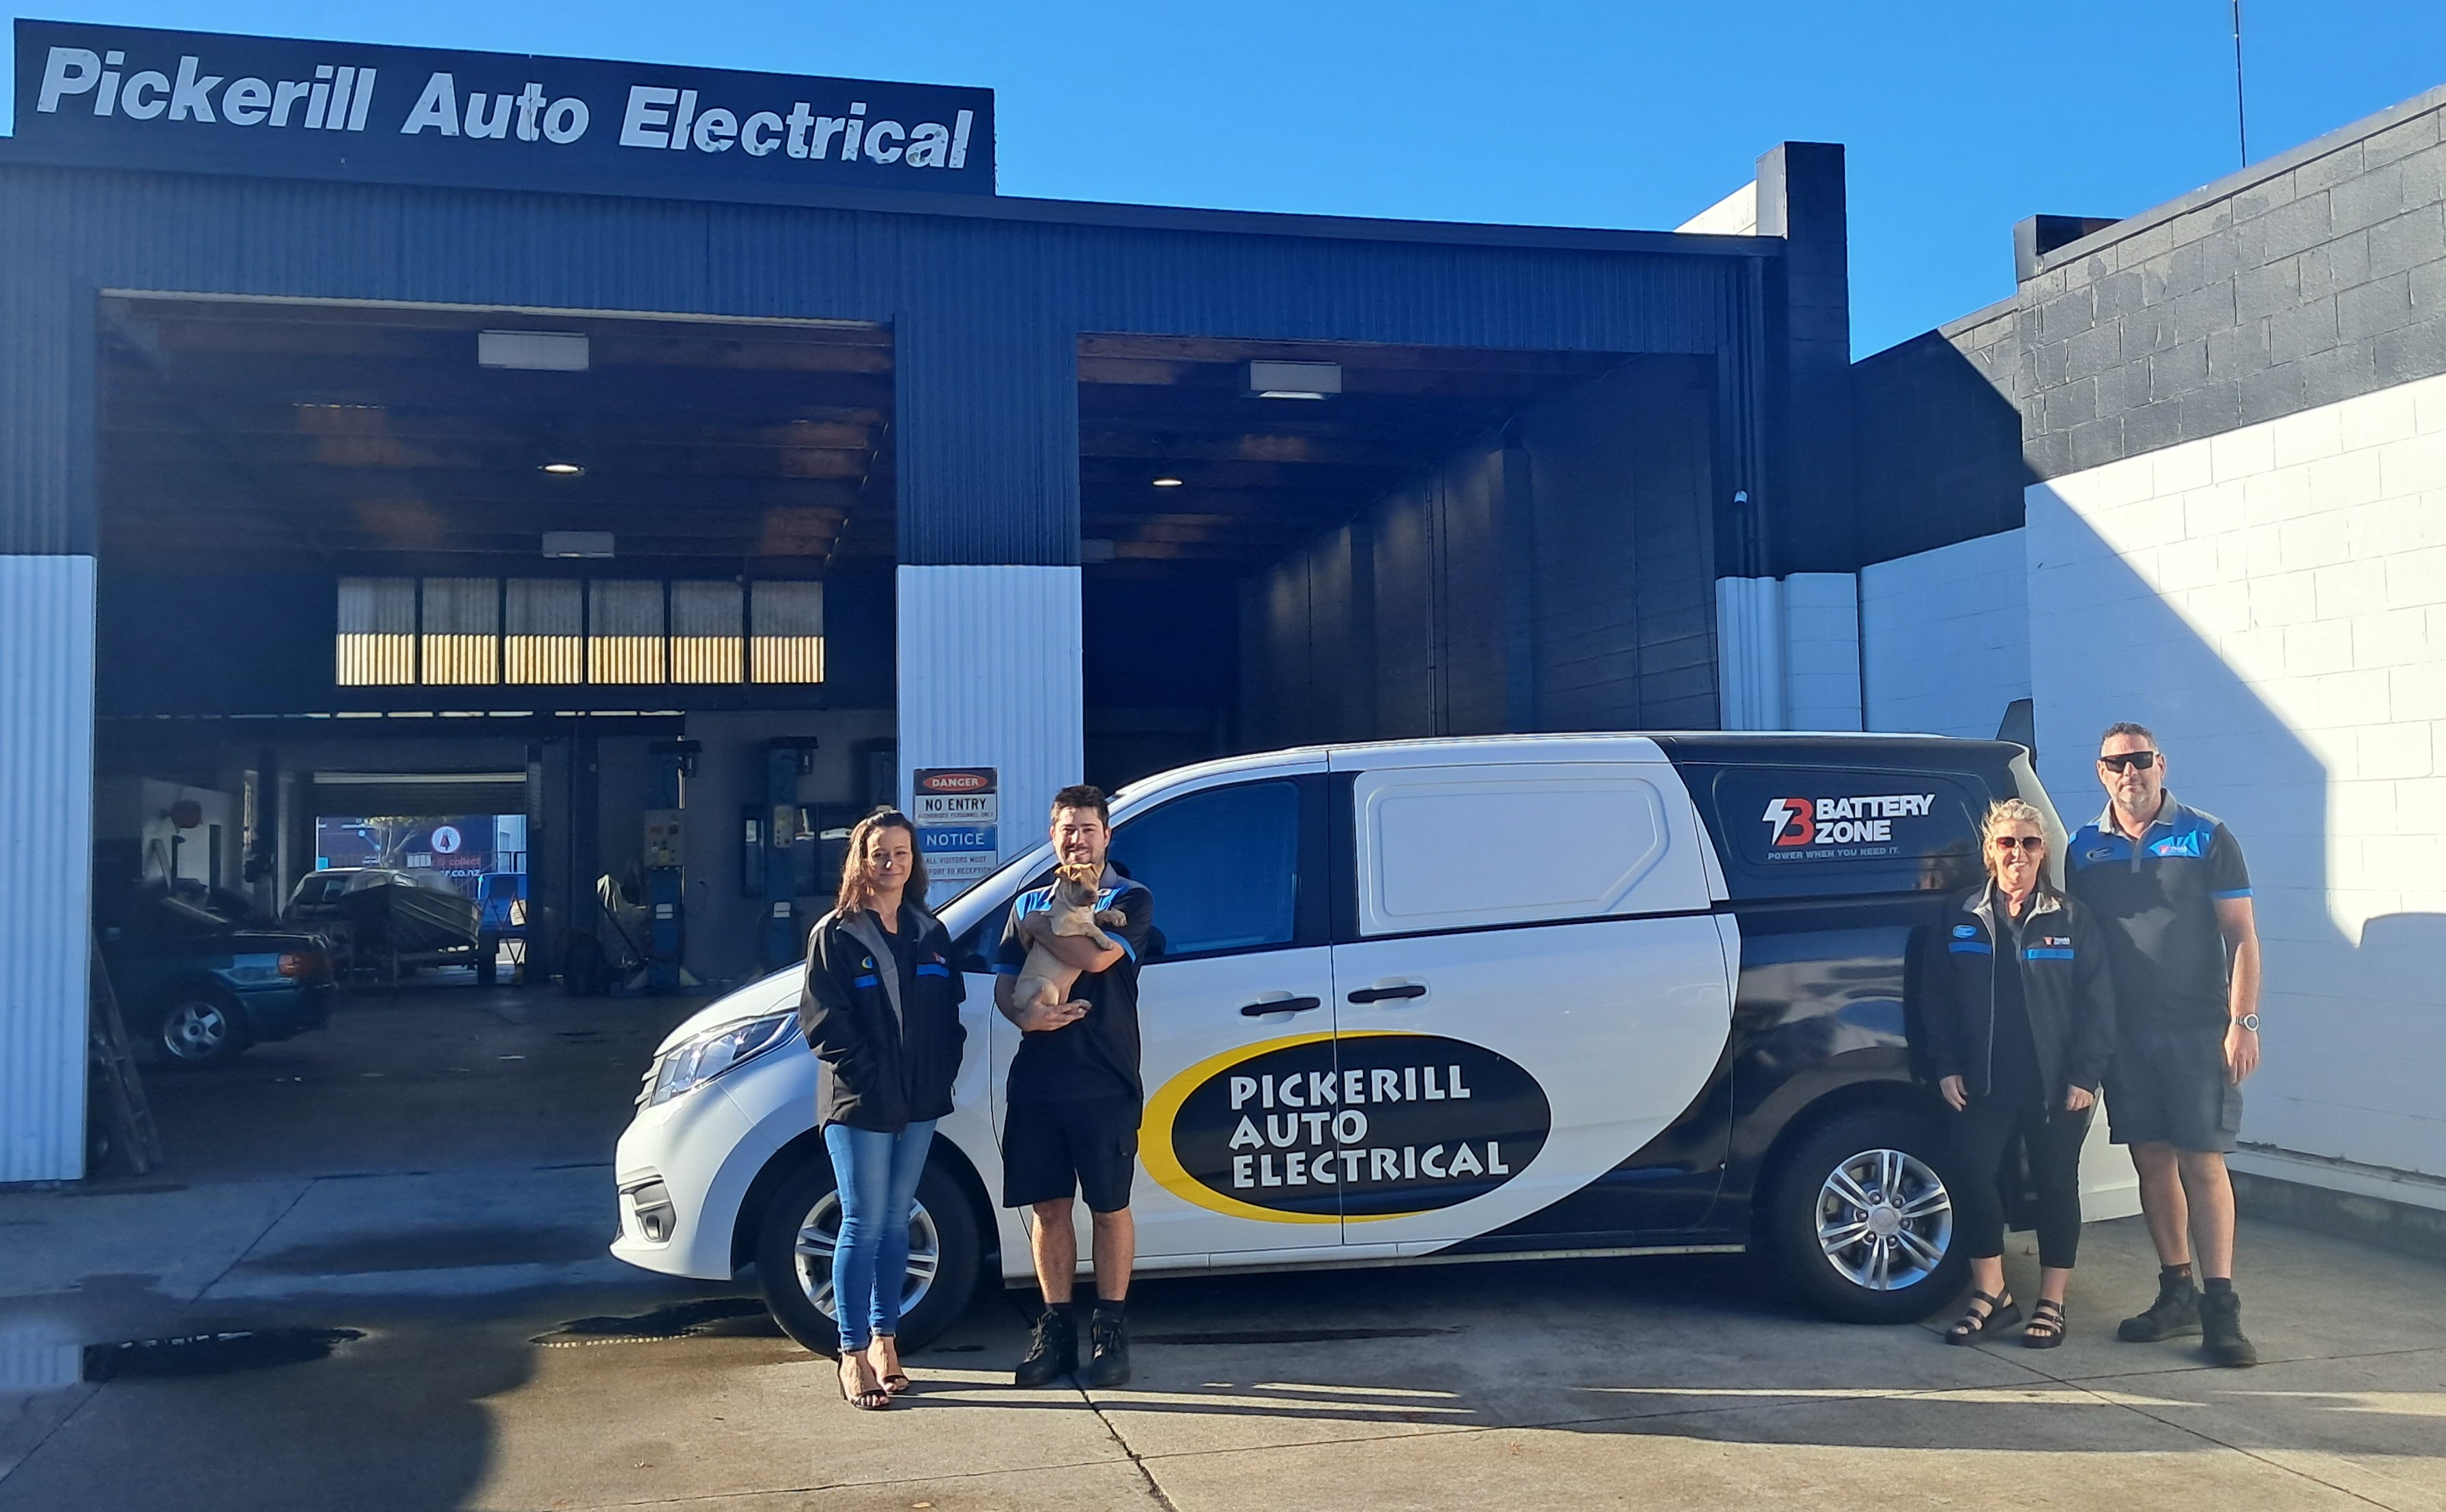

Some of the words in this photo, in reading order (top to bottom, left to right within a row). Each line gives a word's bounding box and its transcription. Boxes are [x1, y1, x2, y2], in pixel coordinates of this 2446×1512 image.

[37, 46, 377, 131] Pickerill
[401, 72, 590, 145] Auto
[618, 85, 974, 169] Electrical
[932, 778, 979, 787] DANGER
[925, 799, 942, 811] NO
[948, 798, 986, 811] ENTRY
[1815, 794, 1936, 820] BATTERY
[926, 832, 985, 846] NOTICE
[1815, 819, 1891, 844] ZONE
[1768, 851, 1803, 860] POWER
[1806, 849, 1834, 858] WHEN
[1860, 847, 1886, 856] NEED
[1229, 1064, 1471, 1111] PICKERILL
[1228, 1109, 1368, 1151] AUTO
[1233, 1141, 1510, 1189] ELECTRICAL
